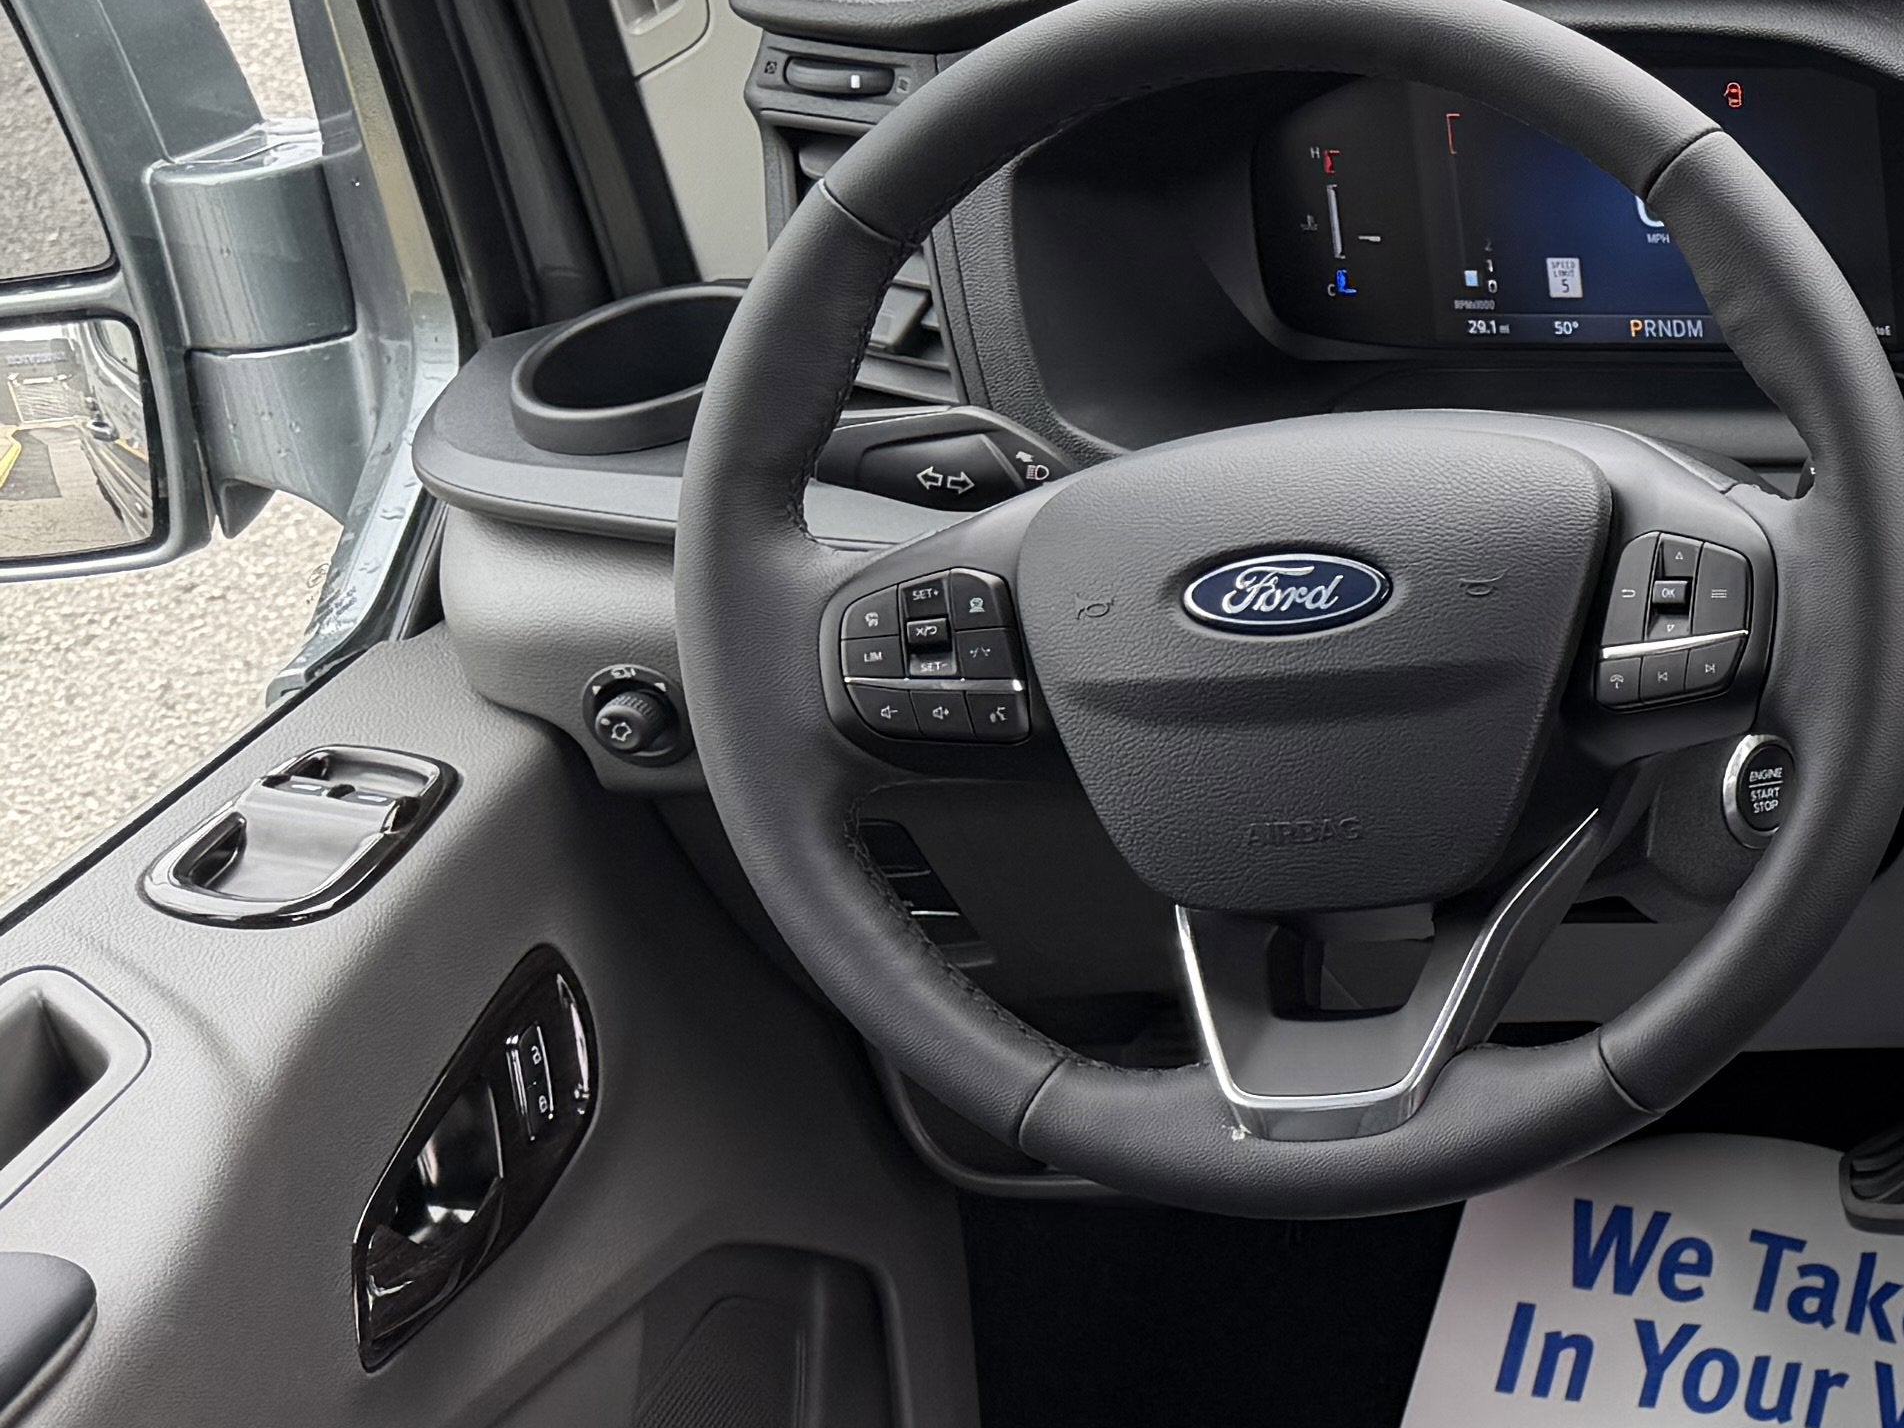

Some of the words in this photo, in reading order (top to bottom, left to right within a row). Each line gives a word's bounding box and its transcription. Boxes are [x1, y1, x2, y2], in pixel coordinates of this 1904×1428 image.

[1561, 278, 1570, 293] 5
[1467, 319, 1498, 334] 29.1
[1553, 320, 1580, 335] 50°
[1221, 565, 1345, 615] Ford
[1749, 767, 1784, 782] ENGINE
[1750, 786, 1781, 801] START
[1753, 800, 1780, 814] STOP
[1246, 816, 1361, 845] AIRBAG
[1572, 1197, 1715, 1303] We
[1493, 1300, 1596, 1403] In
